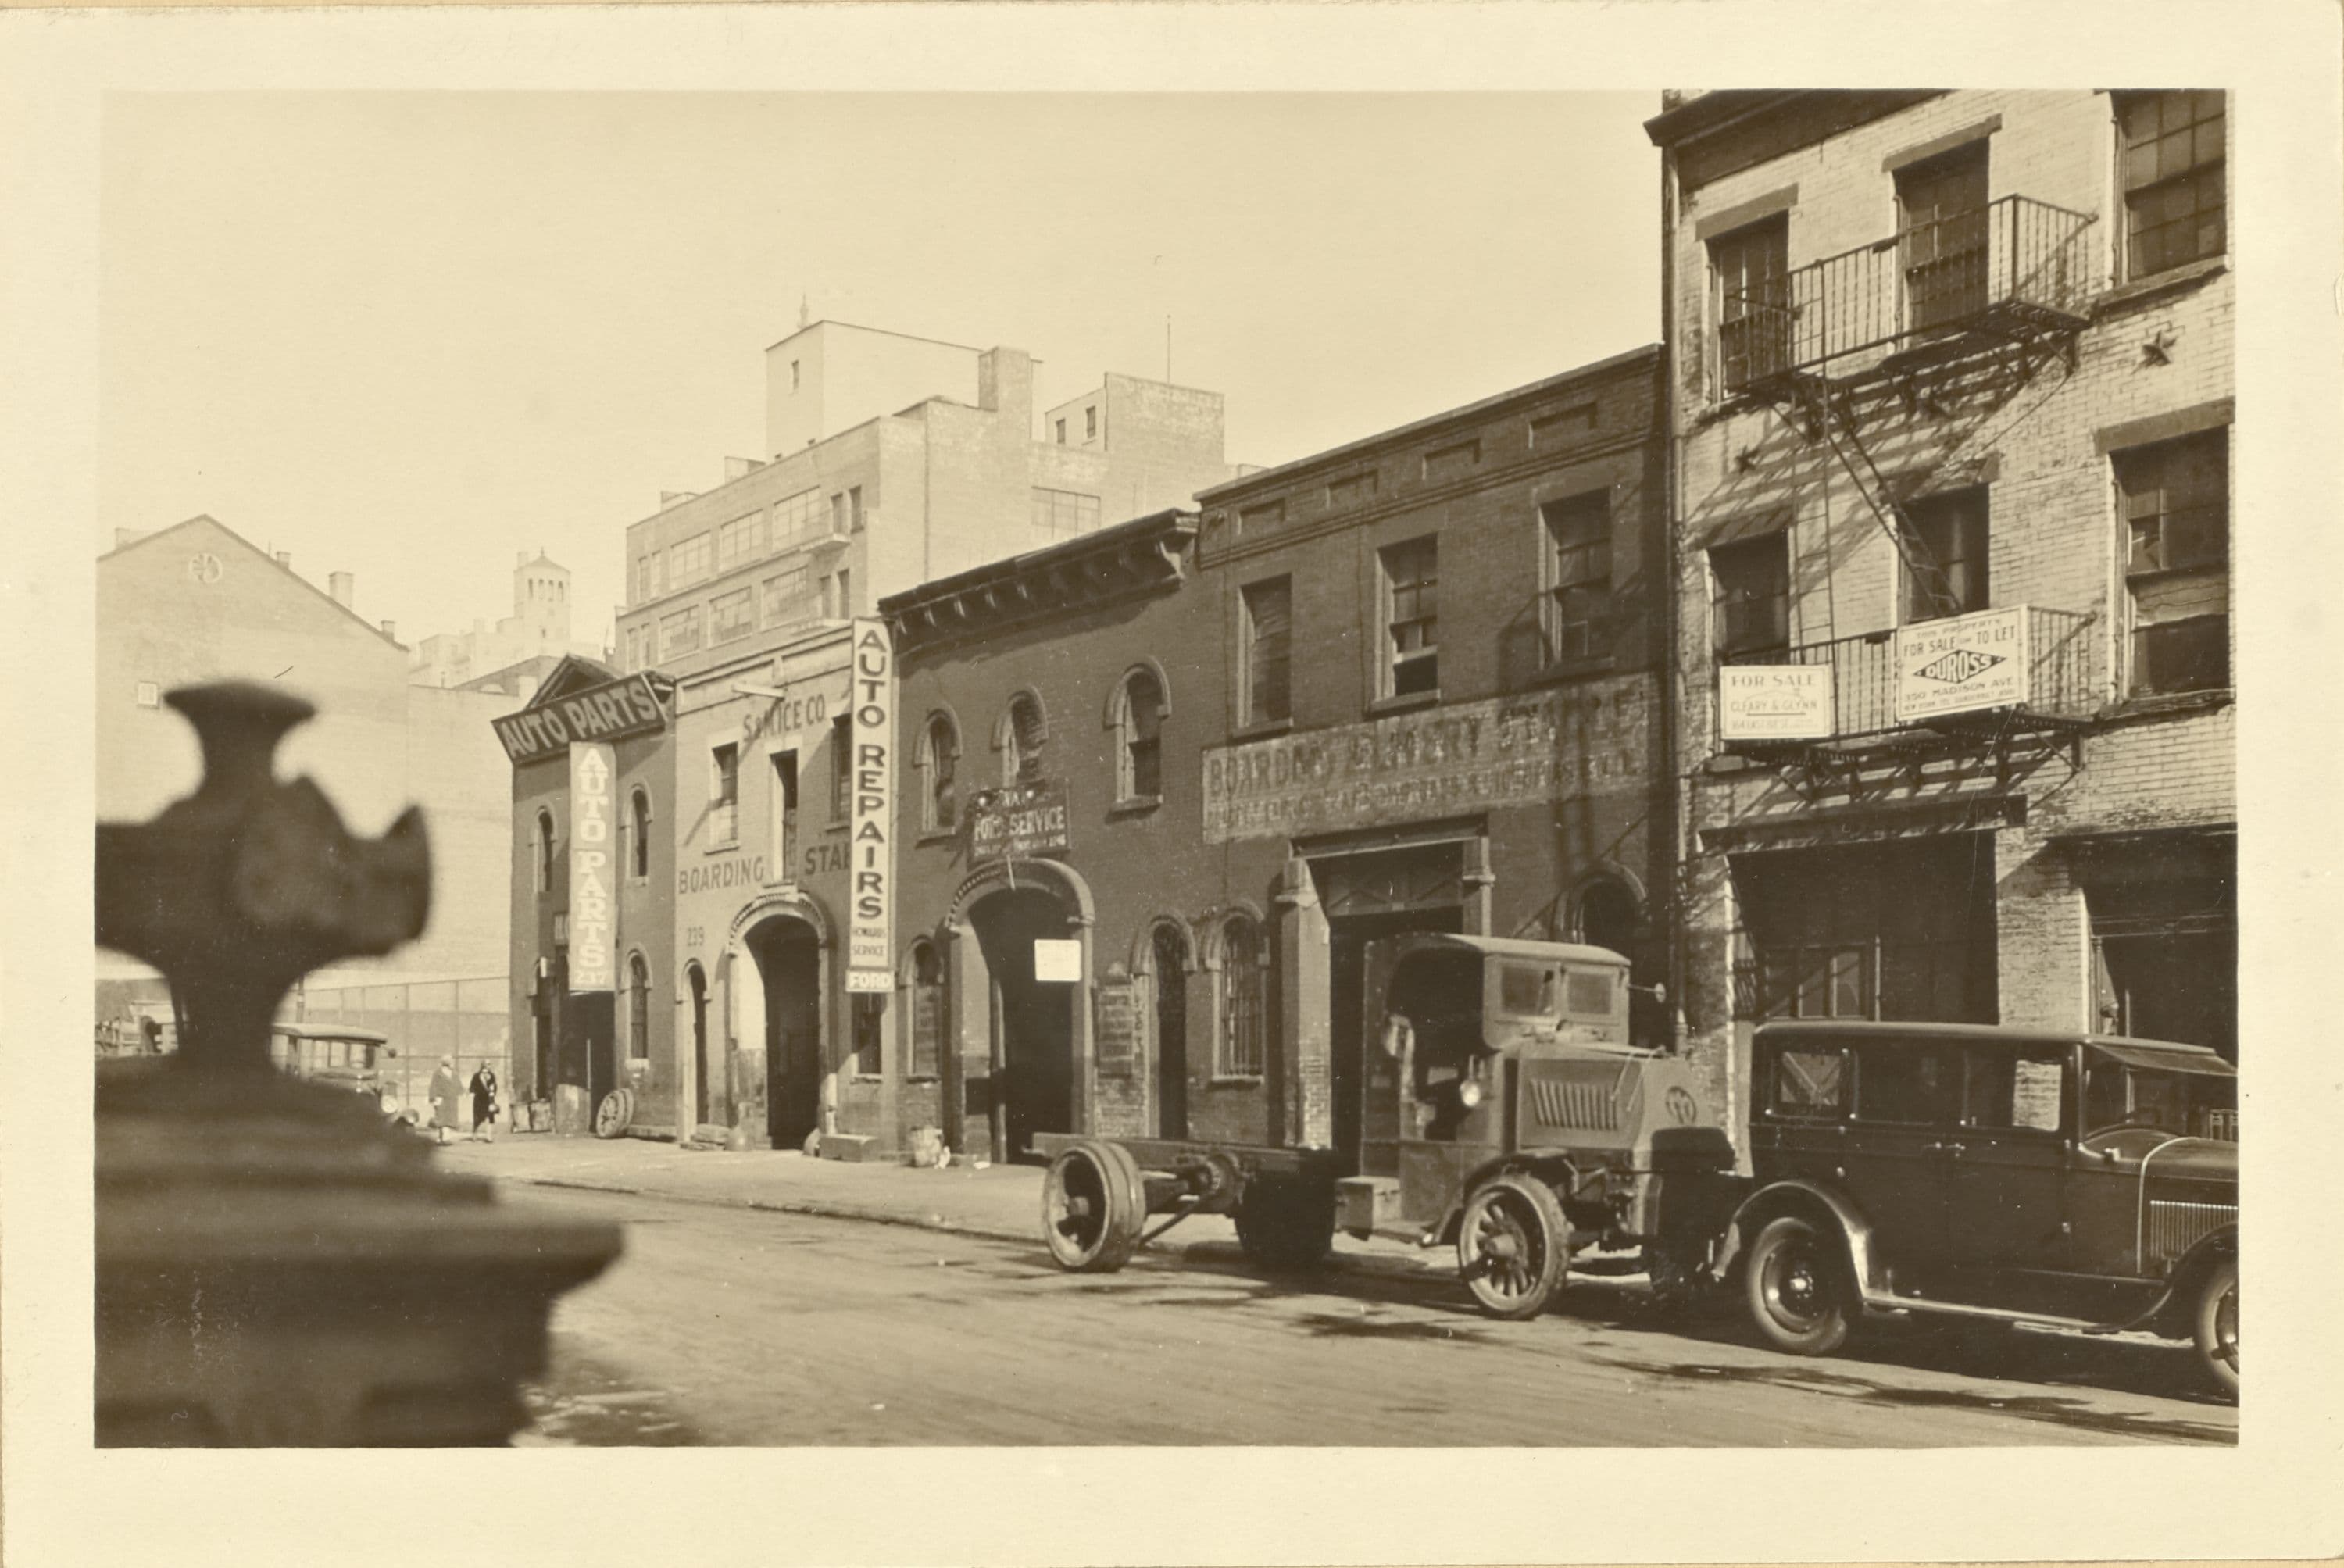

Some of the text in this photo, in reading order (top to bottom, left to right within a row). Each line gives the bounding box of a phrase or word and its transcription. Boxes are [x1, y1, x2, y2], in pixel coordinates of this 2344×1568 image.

[1903, 641, 1924, 657] FOR
[1929, 636, 1956, 654] SALE
[1977, 630, 1989, 645] TO
[1995, 625, 2016, 642] LET
[1731, 674, 1815, 688] FOR SALE
[1925, 651, 1992, 683] DUROSS
[1932, 682, 1985, 697] MADISON
[1992, 677, 2013, 687] AVE
[499, 679, 658, 759] AUTO PARTS
[806, 693, 825, 727] CO
[856, 629, 887, 920] AUTO REPAIRS
[1009, 805, 1066, 836] SERVICE
[577, 747, 609, 968] AUTO PARTS
[678, 856, 765, 895] BOARDING
[852, 944, 884, 957] SERVICE
[574, 970, 607, 985] 237
[849, 970, 892, 988] FORD
